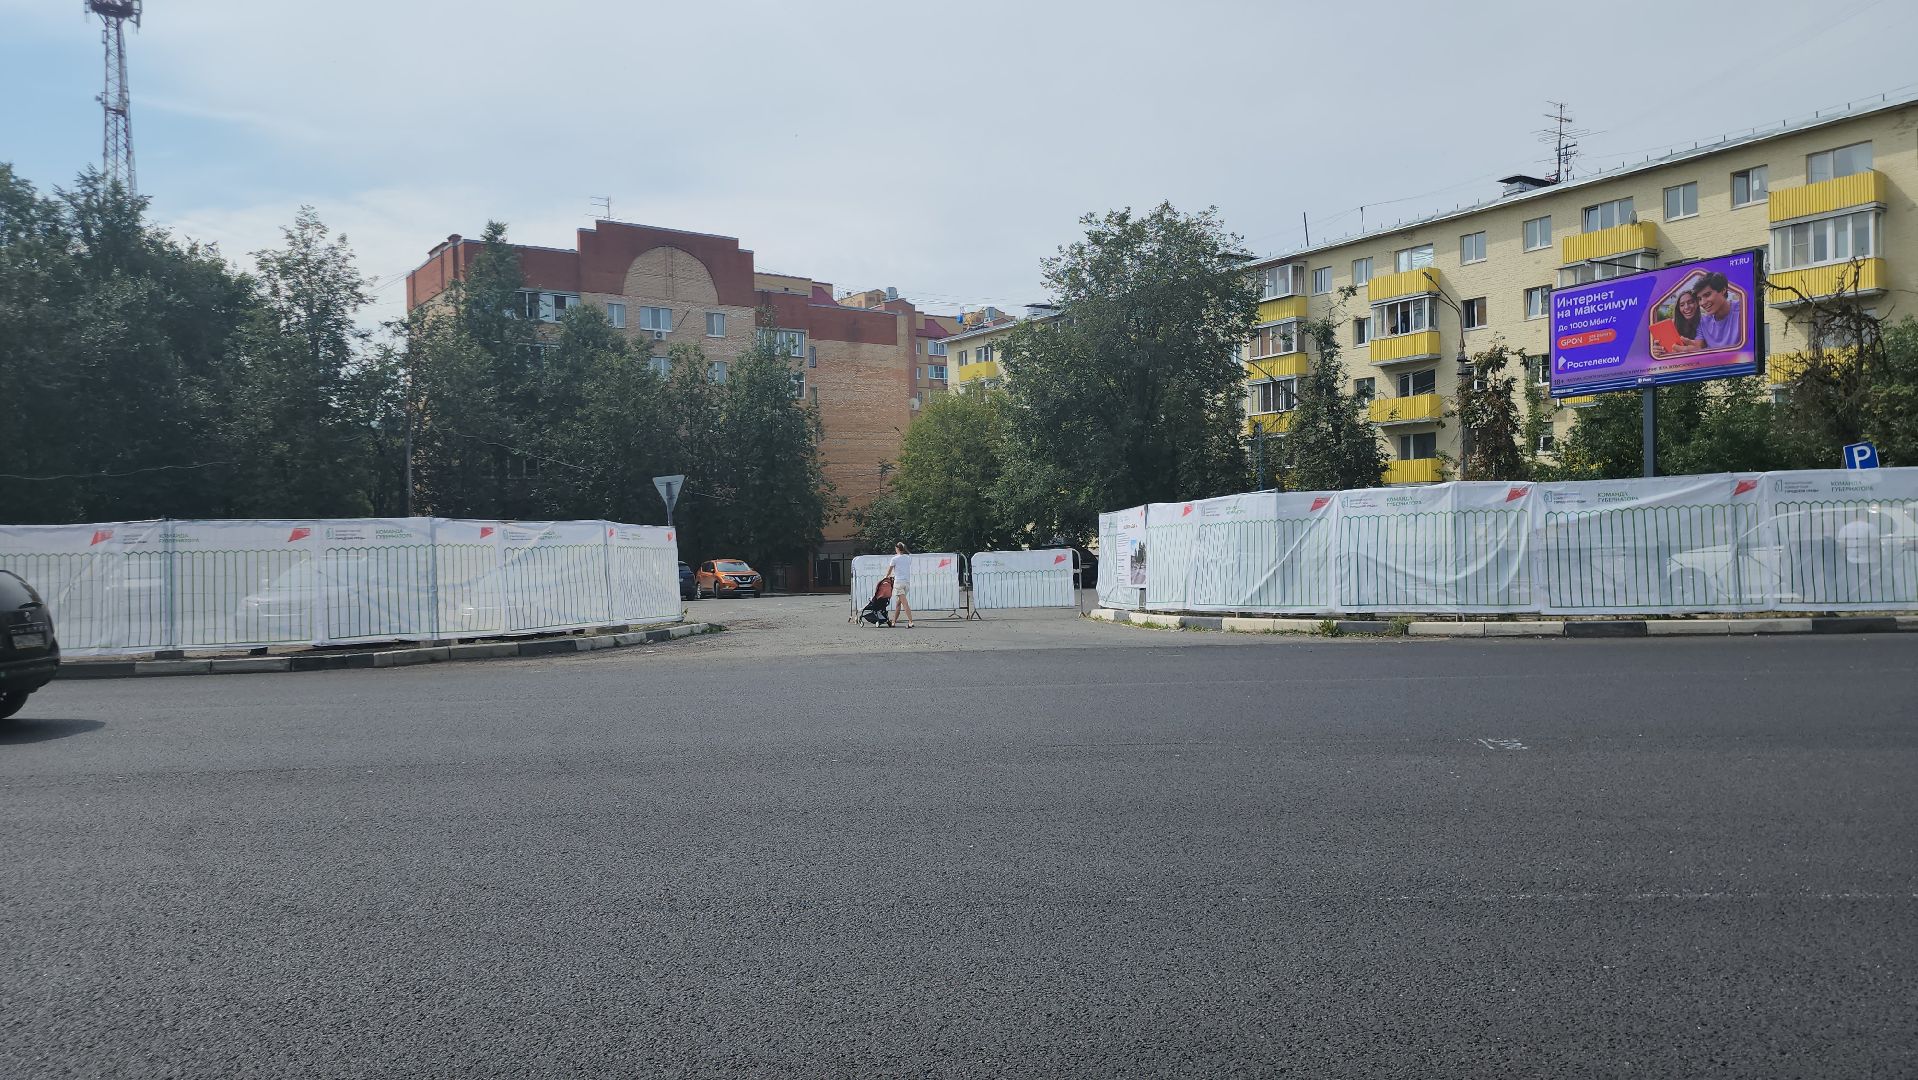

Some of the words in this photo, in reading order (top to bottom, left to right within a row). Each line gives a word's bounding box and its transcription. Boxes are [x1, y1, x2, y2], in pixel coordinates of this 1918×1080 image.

[1730, 257, 1750, 267] RT.RU
[1557, 290, 1614, 308] Интернет
[1557, 309, 1571, 319] на
[1574, 297, 1638, 316] максимум
[1558, 324, 1568, 332] До
[1570, 320, 1588, 330] 1000
[1589, 315, 1617, 327] Мбит/с
[1560, 336, 1583, 347] GPON
[1567, 356, 1620, 369] Ростелеком
[1554, 378, 1564, 386] 18+
[1852, 445, 1871, 469] P
